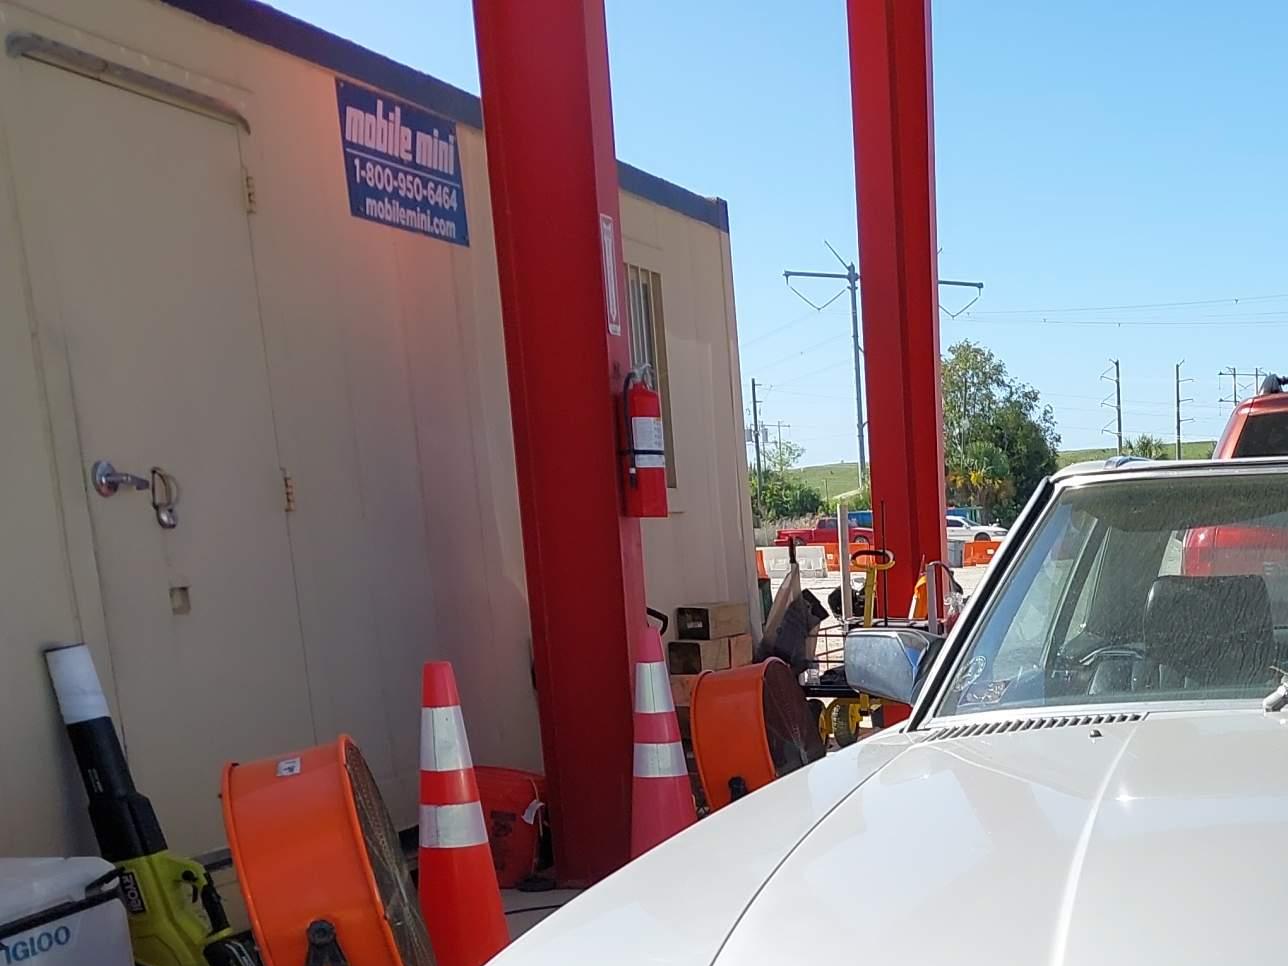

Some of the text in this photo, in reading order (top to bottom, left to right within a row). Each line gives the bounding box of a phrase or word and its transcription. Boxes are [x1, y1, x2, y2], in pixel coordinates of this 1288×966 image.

[345, 99, 454, 175] mobile mini
[354, 158, 457, 211] 1-800-950-6464
[366, 197, 456, 238] mobilemini.com
[4, 926, 71, 965] IGLOO
